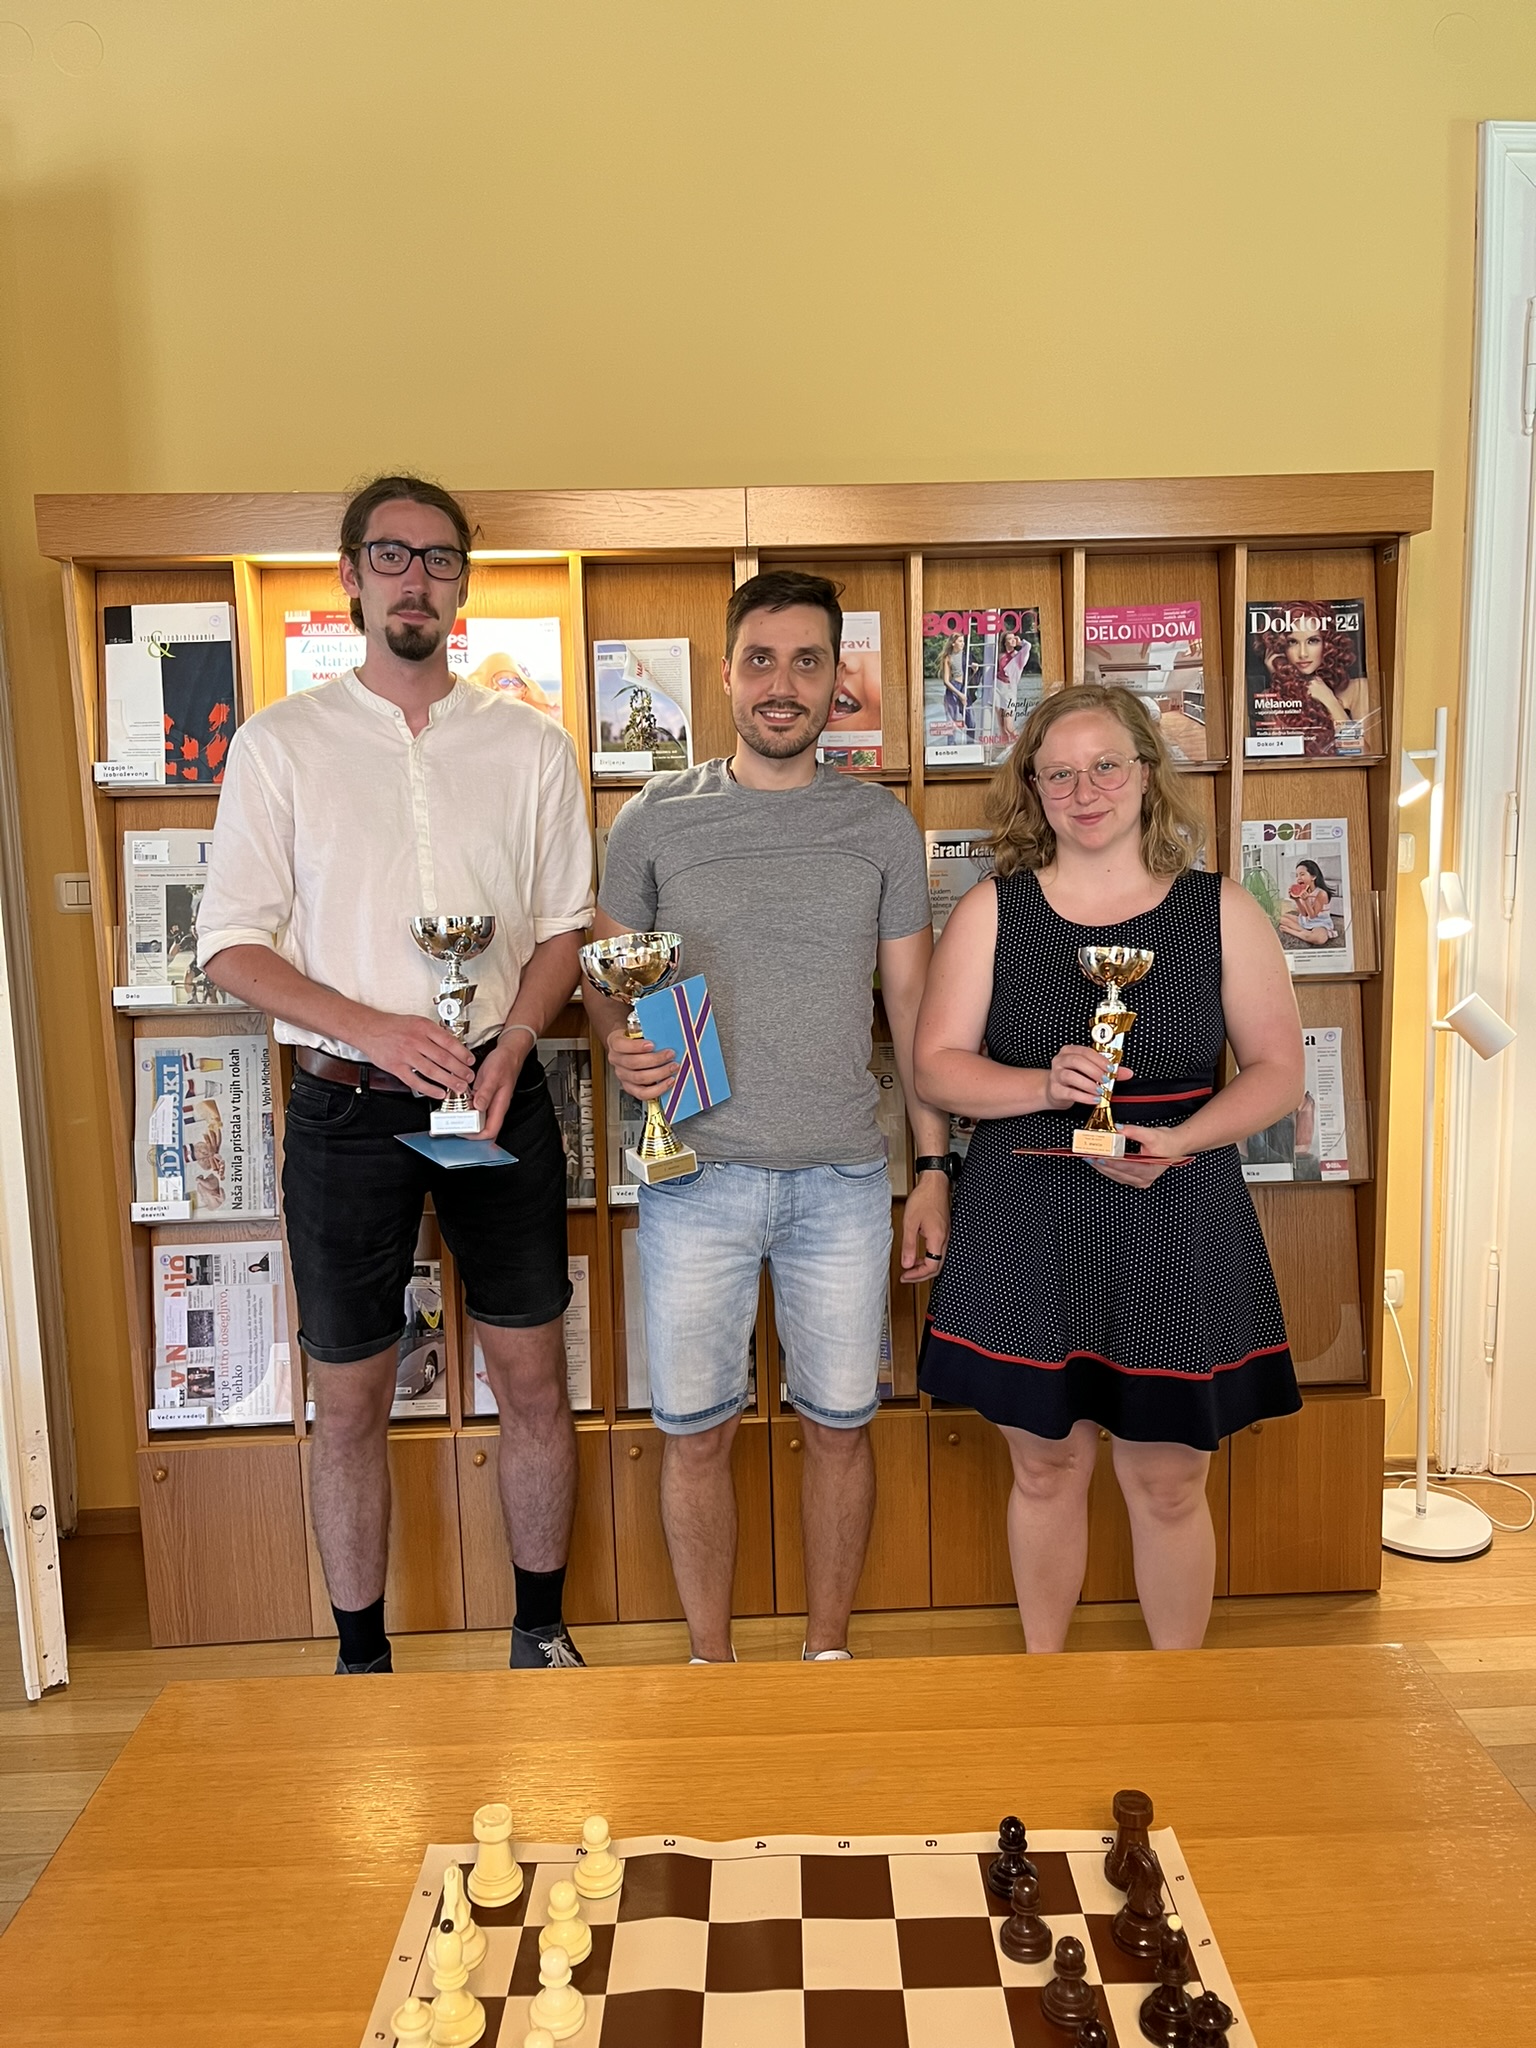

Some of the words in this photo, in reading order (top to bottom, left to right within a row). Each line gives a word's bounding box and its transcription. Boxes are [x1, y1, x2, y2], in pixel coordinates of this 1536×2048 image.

[301, 623, 353, 634] ZAKLADNICA
[1249, 610, 1333, 634] Doktor
[1336, 614, 1359, 631] 24
[447, 633, 468, 648] PS
[841, 636, 871, 649] ravi
[447, 651, 469, 664] est
[1254, 699, 1303, 709] Melanom
[229, 1048, 240, 1078] rokah
[260, 1048, 271, 1086] Michelina
[230, 1080, 244, 1104] tujih
[262, 1086, 272, 1107] Vpliv
[230, 1114, 244, 1153] pristala
[231, 1155, 243, 1182] živila
[231, 1185, 243, 1210] Naša
[216, 1289, 231, 1347] dosegljivo,
[217, 1349, 230, 1377] hitro
[218, 1380, 230, 1392] je
[231, 1365, 246, 1403] plehko
[663, 1839, 676, 1847] 3
[754, 1840, 767, 1850] 4
[838, 1840, 850, 1849] 5
[925, 1839, 938, 1848] 6
[1101, 1836, 1114, 1845] 8
[375, 2032, 385, 2040] c
